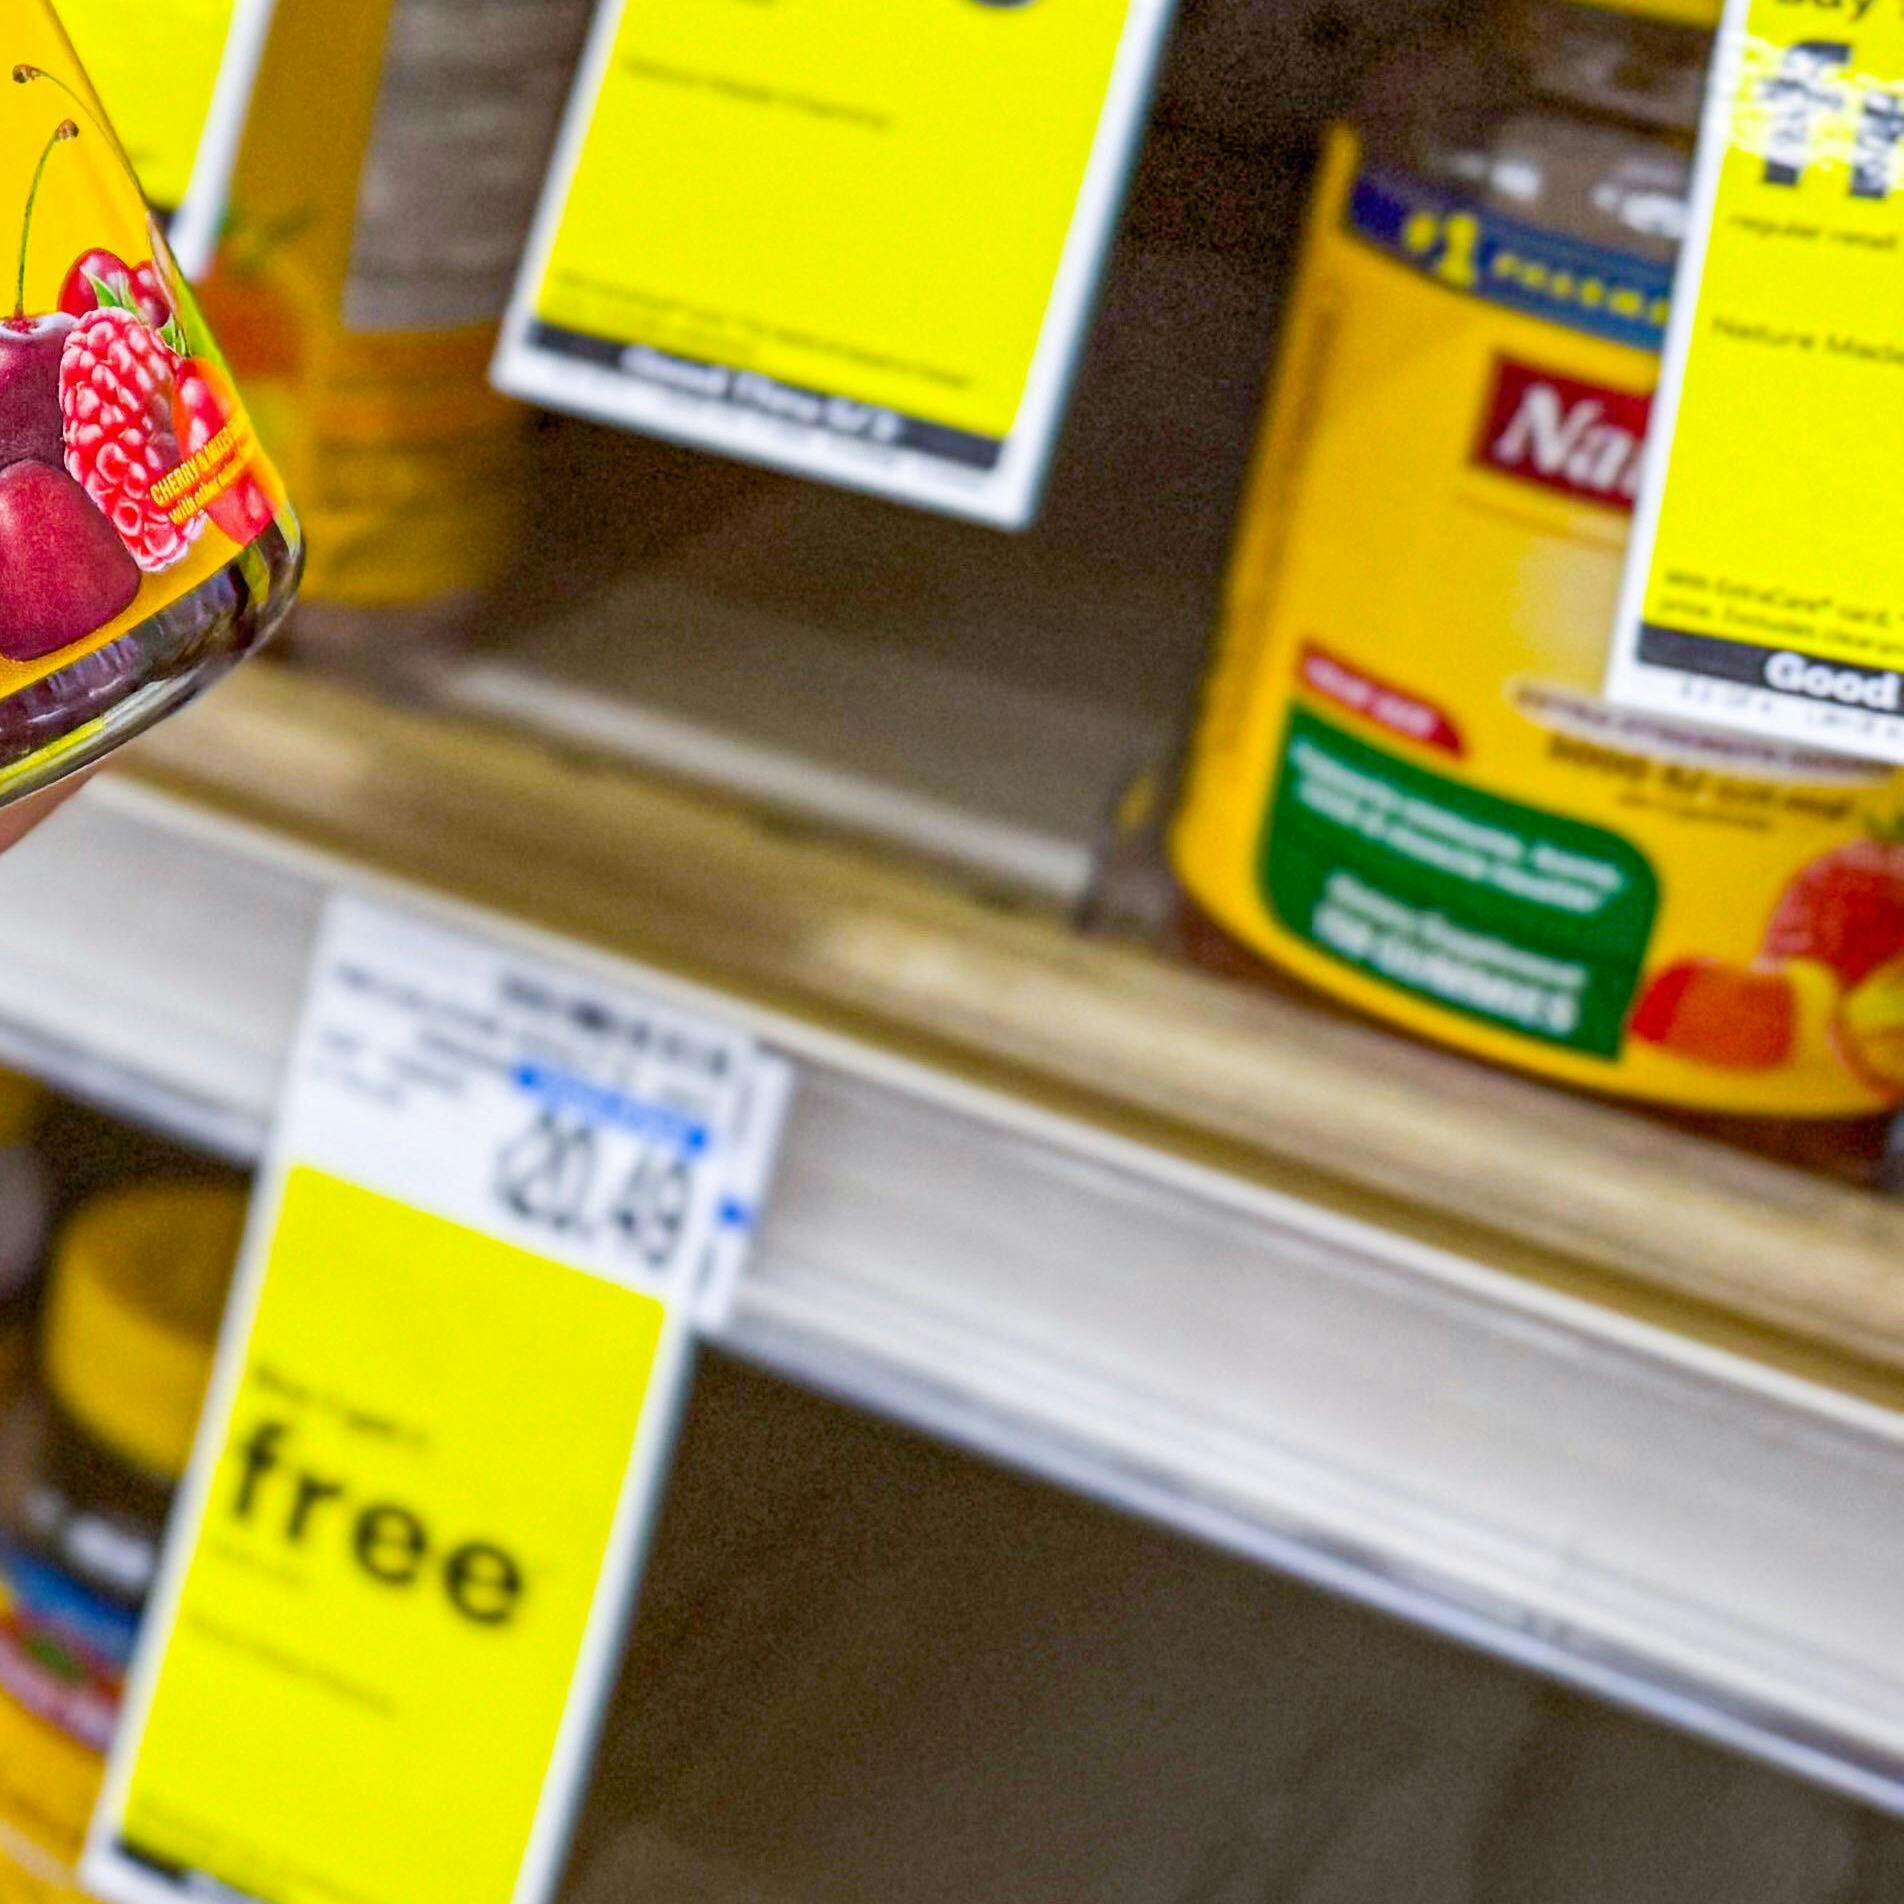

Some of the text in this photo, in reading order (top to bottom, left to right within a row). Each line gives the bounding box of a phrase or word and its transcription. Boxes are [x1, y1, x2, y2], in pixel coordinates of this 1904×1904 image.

[149, 455, 200, 506] CHERRY
[1763, 649, 1902, 712] Good
[227, 1416, 524, 1628] free
